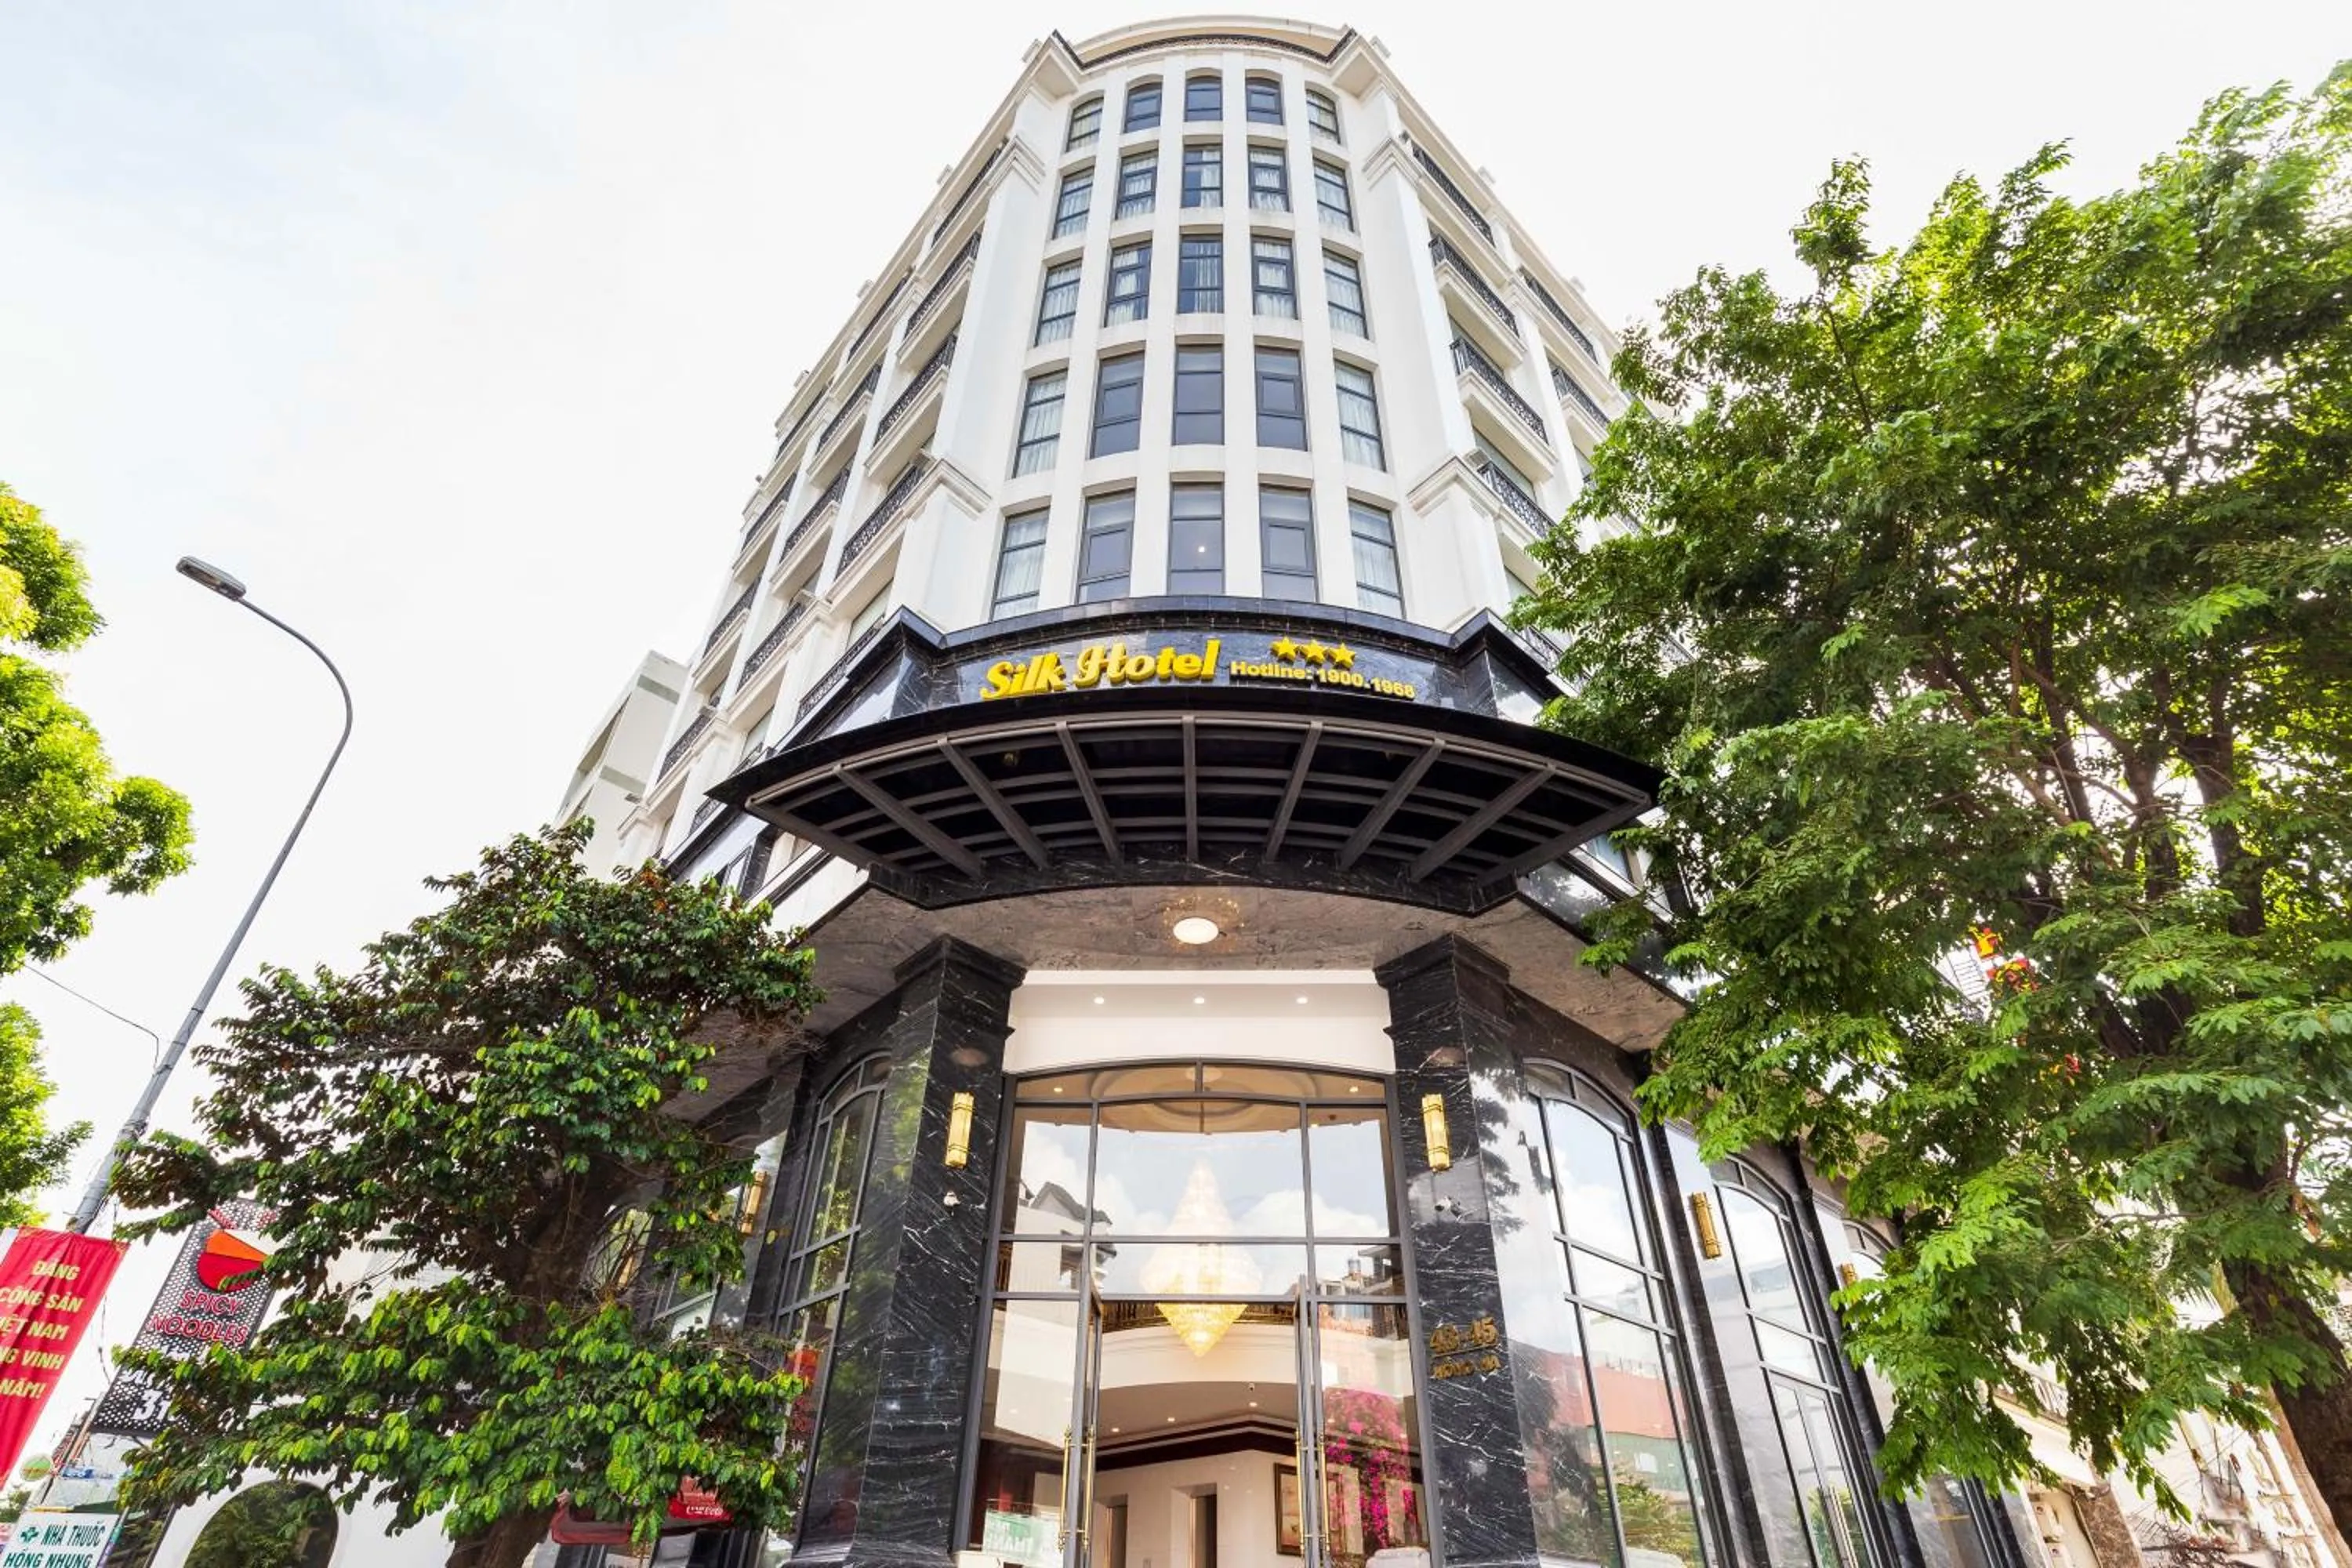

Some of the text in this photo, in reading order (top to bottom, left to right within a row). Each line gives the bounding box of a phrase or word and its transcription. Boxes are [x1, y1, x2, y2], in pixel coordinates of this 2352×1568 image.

[980, 637, 1221, 700] Silk Hotel
[1229, 661, 1313, 680] Hotline:
[45, 1291, 85, 1312] SẢN
[178, 1289, 244, 1316] SPICY
[27, 1321, 70, 1340] NAM
[145, 1313, 250, 1346] NOODLES
[22, 1350, 65, 1370] VINH
[41, 1521, 67, 1545] NHÀ
[3, 1547, 93, 1568] HỒNG NHUNG
